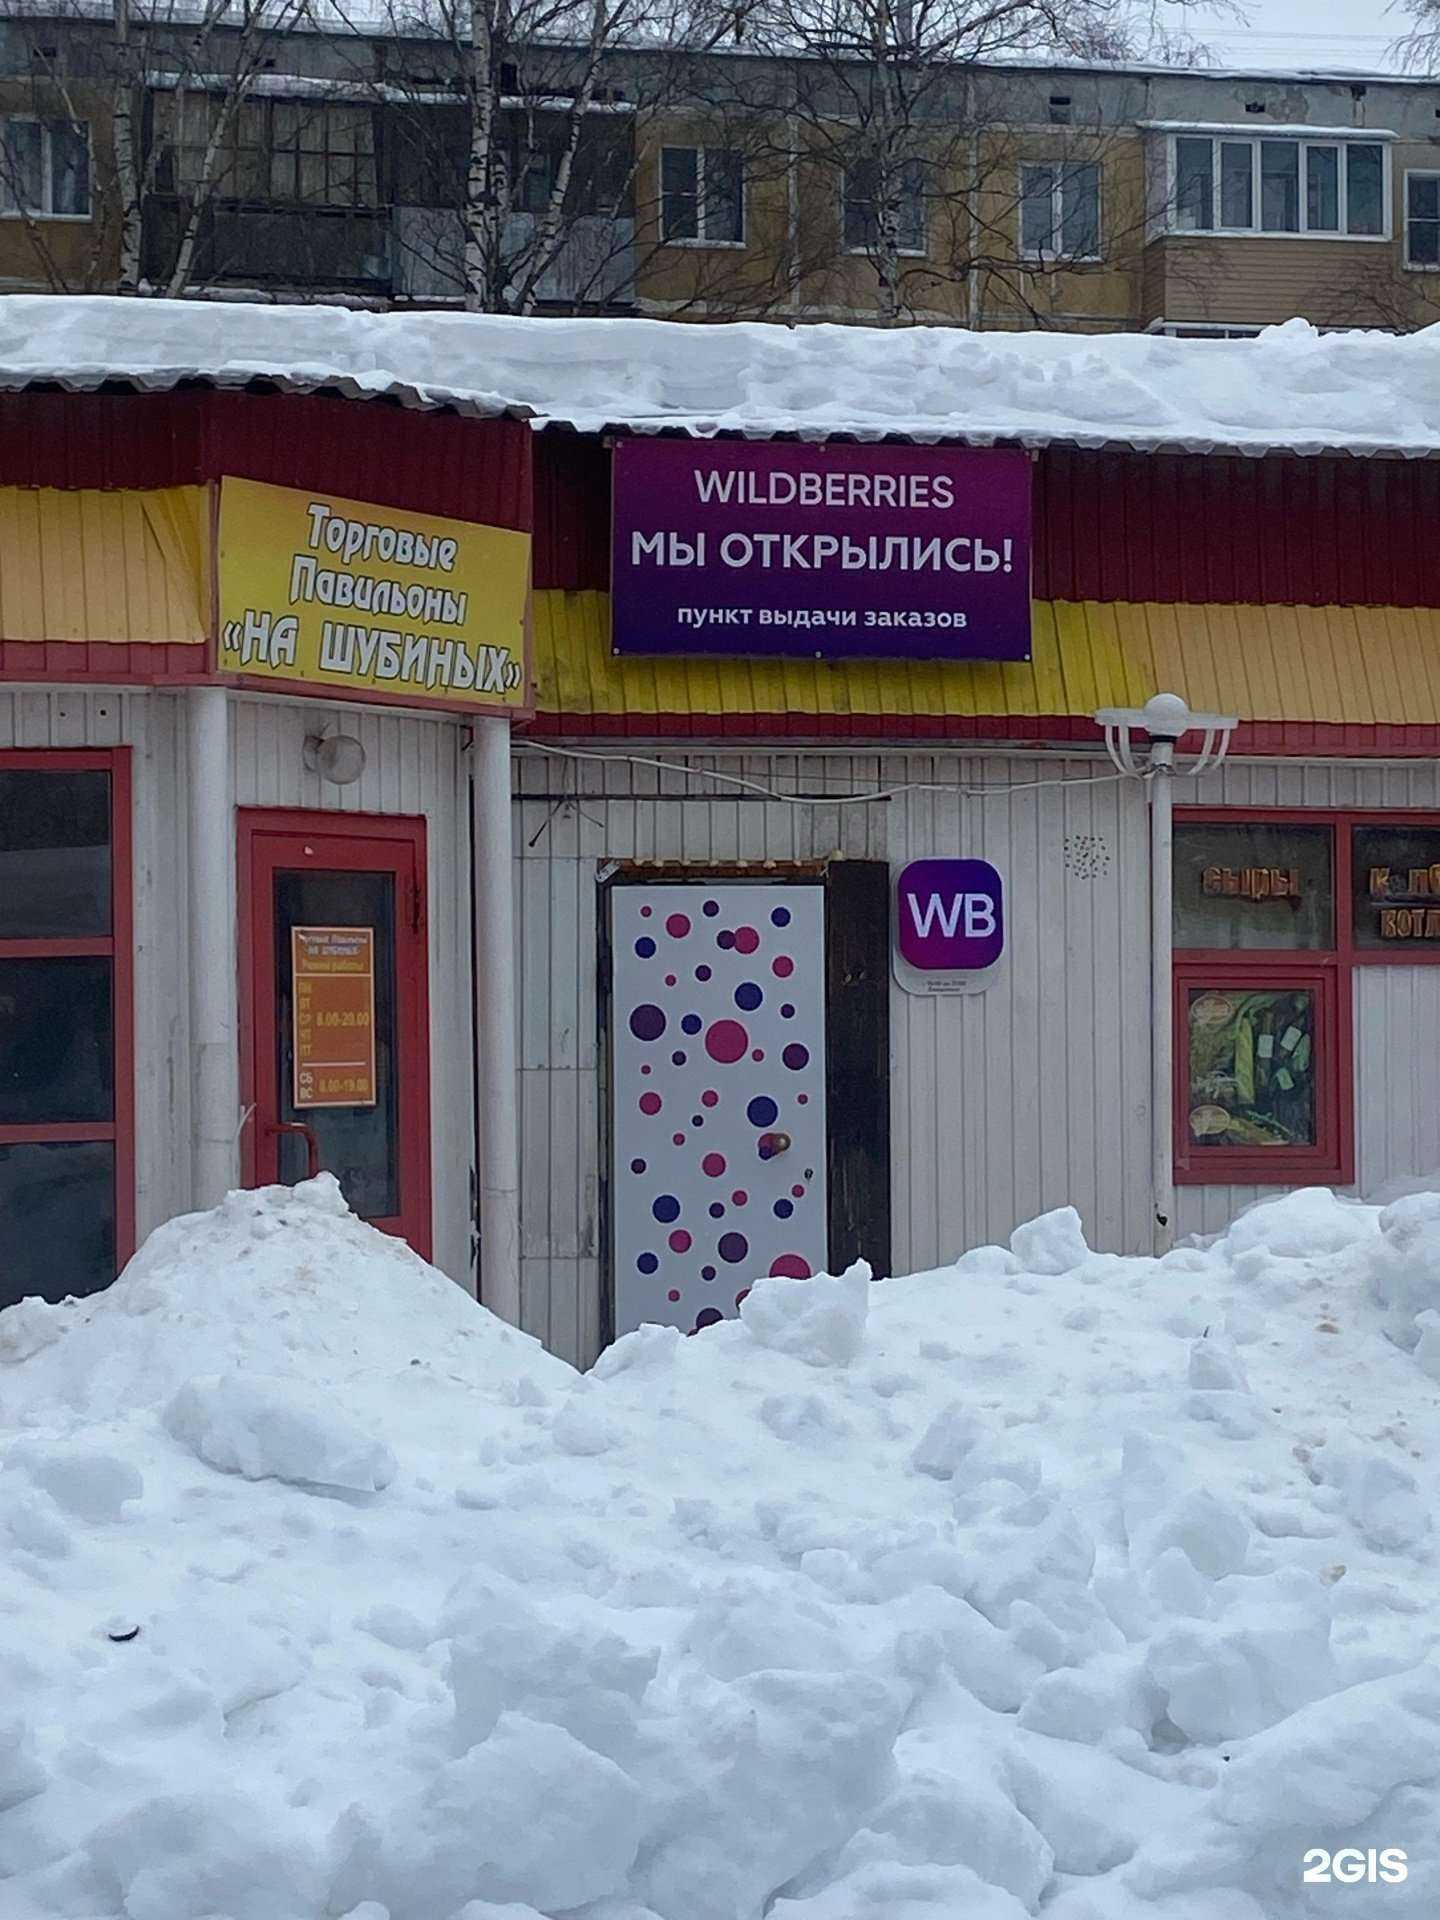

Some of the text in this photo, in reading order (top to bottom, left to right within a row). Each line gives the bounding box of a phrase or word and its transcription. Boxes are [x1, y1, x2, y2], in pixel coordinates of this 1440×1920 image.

[694, 470, 954, 508] WILDBERRIES
[307, 502, 458, 572] Торговые
[631, 531, 1013, 573] МЫ ОТКРЫЛИСЬ!
[289, 554, 468, 625] Павильоны
[677, 607, 968, 629] пункт выдачи заказов
[222, 608, 522, 694] «НА ШУБИНЫХ»
[906, 892, 997, 938] WB
